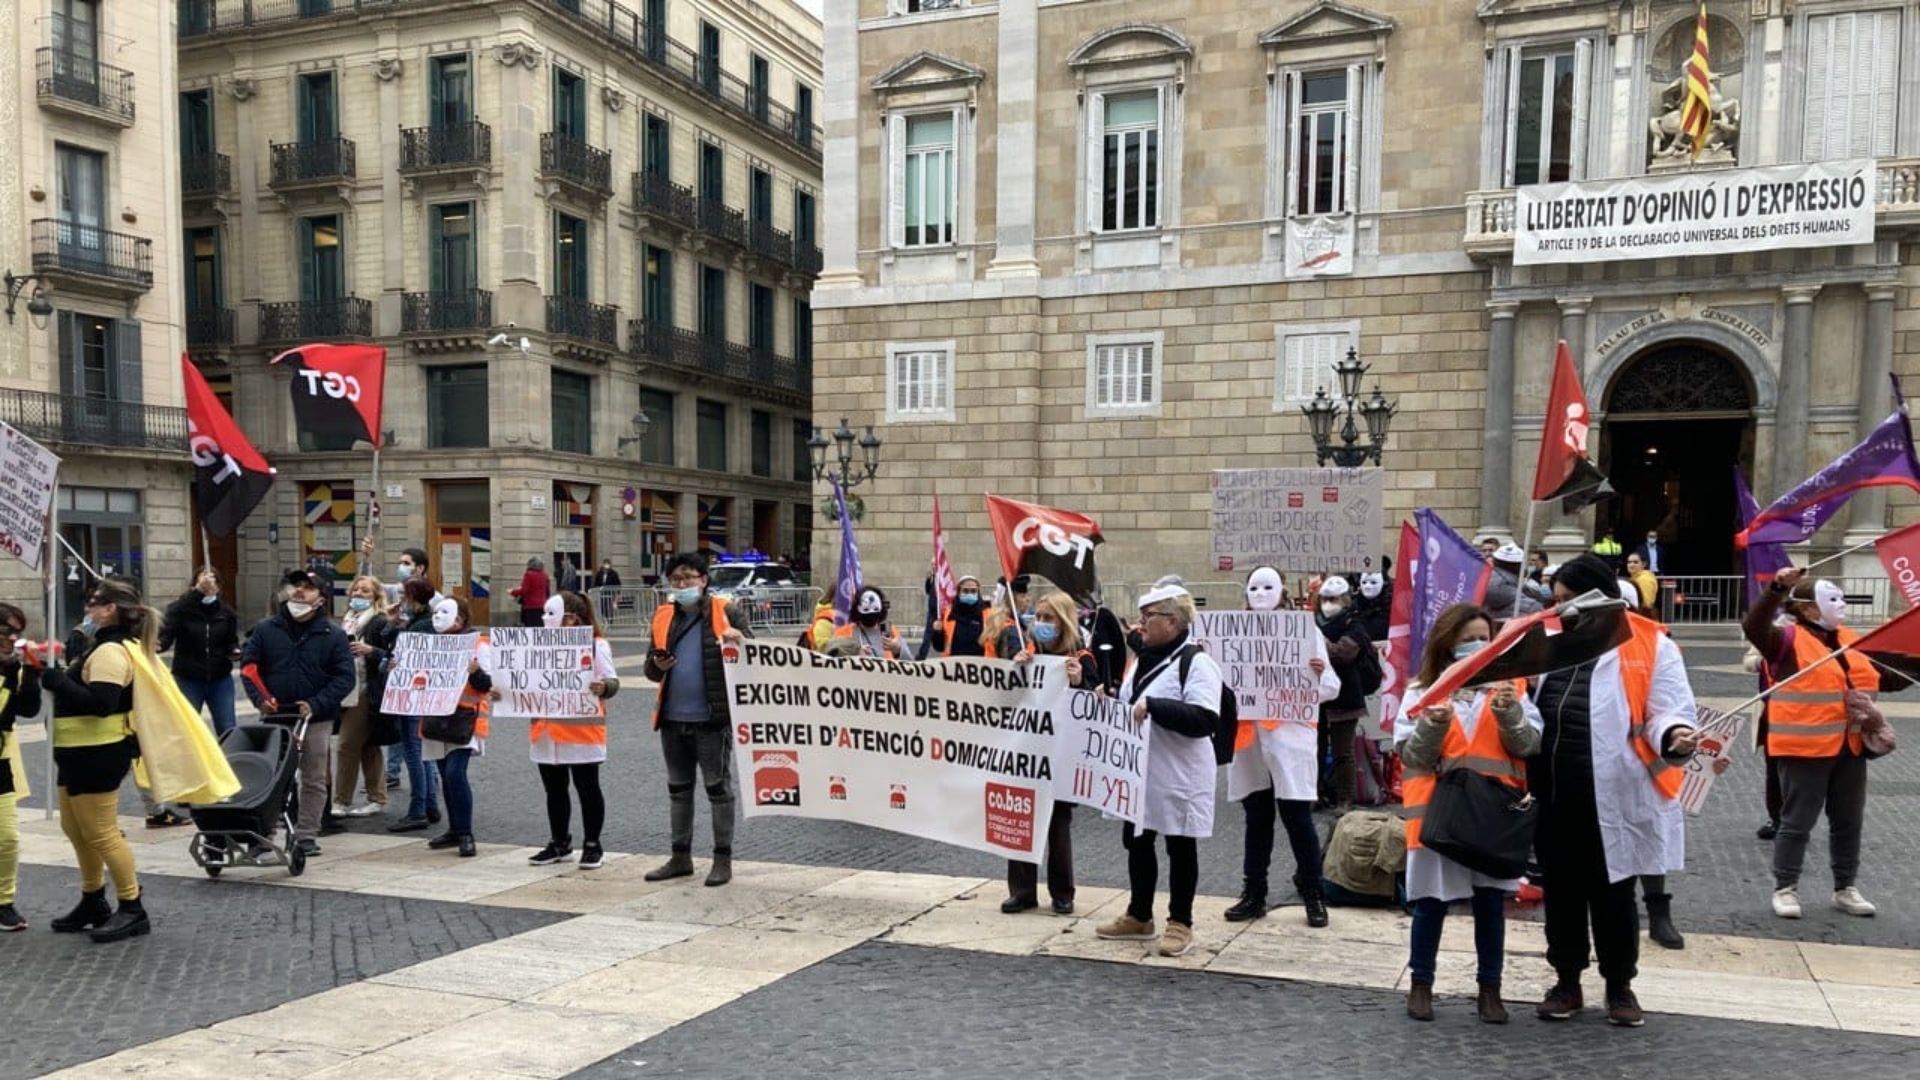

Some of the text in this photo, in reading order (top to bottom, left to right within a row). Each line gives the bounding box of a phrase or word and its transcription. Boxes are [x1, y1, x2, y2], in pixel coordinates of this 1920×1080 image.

[1527, 169, 1865, 231] LLIBERTAT D'OPINIÓ I D'EXPRESSIÓ
[1538, 238, 1573, 252] ARTICLE
[1577, 237, 1588, 249] 19
[1590, 237, 1602, 249] DE
[1604, 235, 1617, 248] LA
[1684, 228, 1738, 243] UNIVERSAL
[1742, 225, 1767, 239] DELS
[1769, 222, 1800, 238] DRETS
[1803, 218, 1850, 234] HUMANS
[1598, 309, 1768, 355] PALAU DE LA GENERALITAT
[1012, 517, 1093, 570] CGT
[1344, 534, 1368, 553] DE
[493, 629, 529, 648] SOMOS
[498, 648, 577, 670] DE LIMPIEZA
[745, 645, 803, 668] PROU
[510, 670, 583, 691] NO SOMOS
[512, 691, 599, 716] INVISIBLES
[735, 683, 1055, 736] EXIGIM CONVENI DE BARCELONA
[1267, 703, 1313, 721] DIGNO
[737, 722, 1052, 781] SERVEI D'ATENCIÓ DOMICILIARIA
[758, 788, 798, 802] CGT
[988, 788, 1032, 815] co.bas
